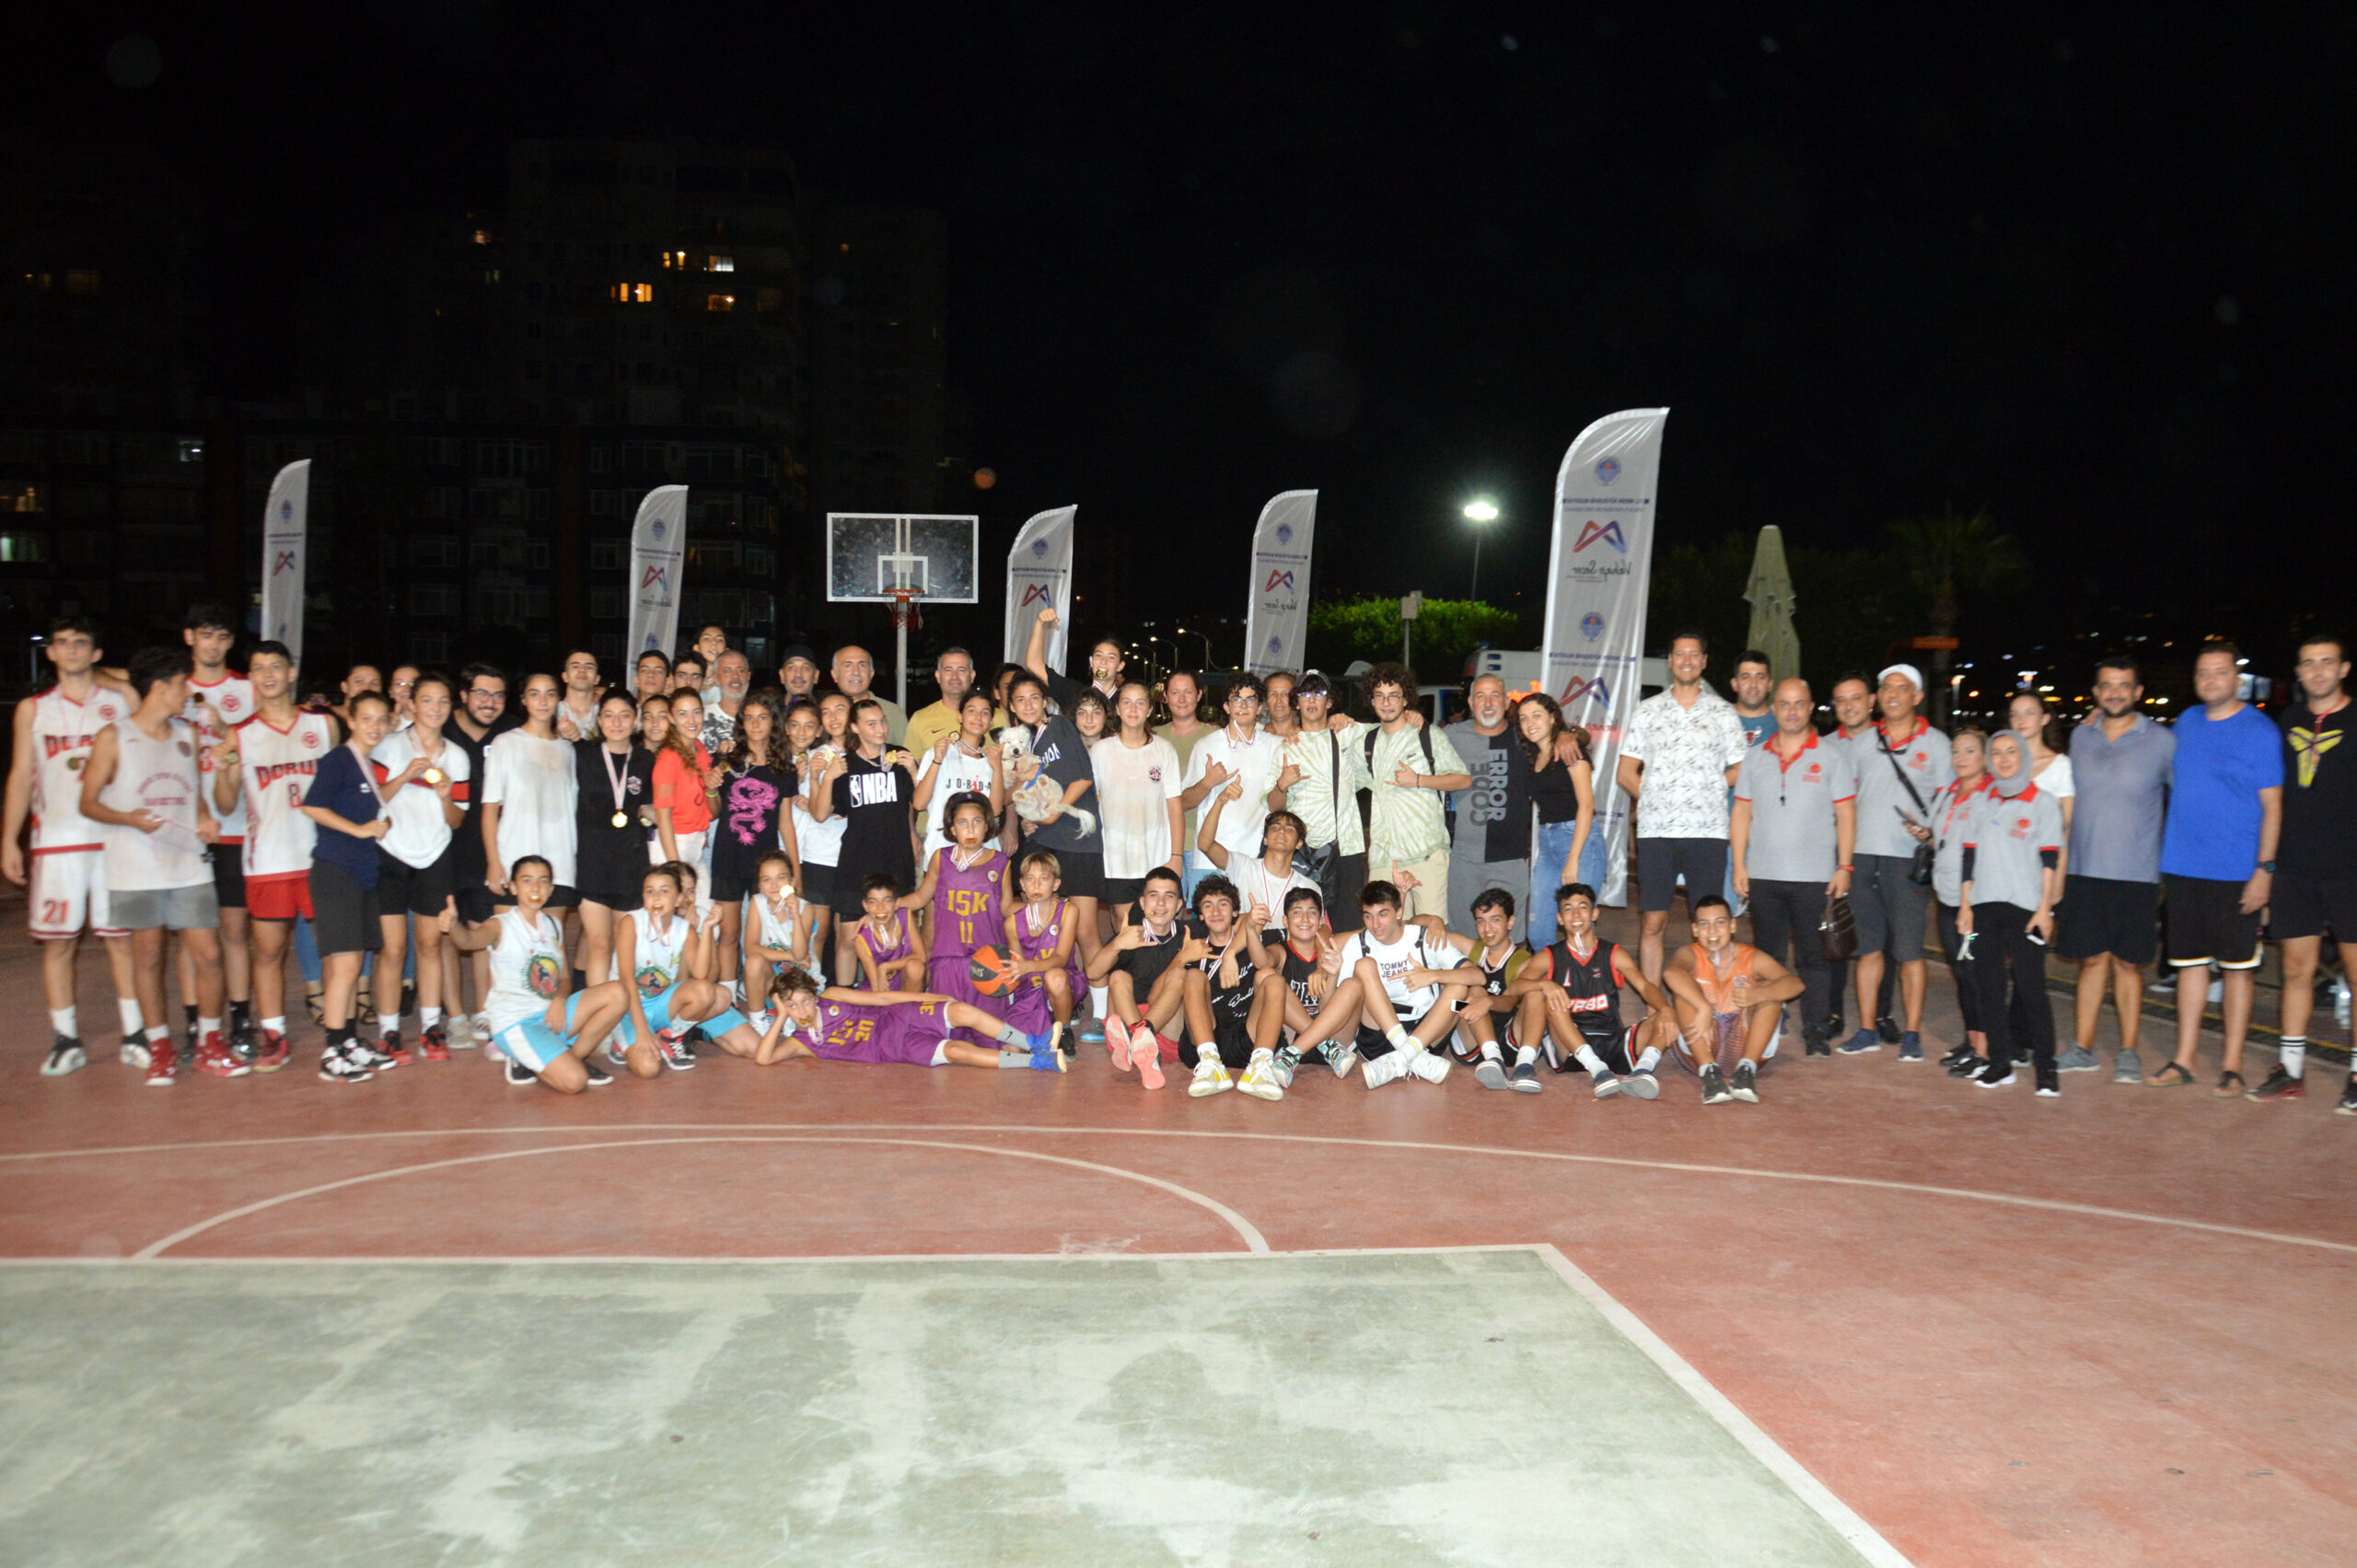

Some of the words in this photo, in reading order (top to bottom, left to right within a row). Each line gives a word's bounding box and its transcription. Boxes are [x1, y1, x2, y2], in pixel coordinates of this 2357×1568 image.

[255, 757, 320, 792] DORU
[862, 772, 898, 805] NBA
[946, 778, 991, 792] JORDA
[1489, 749, 1508, 821] ERROR
[1469, 763, 1490, 826] CODE
[43, 900, 69, 923] 21
[947, 889, 990, 917] ISK
[959, 921, 974, 944] 11
[1380, 958, 1409, 970] TOMMY
